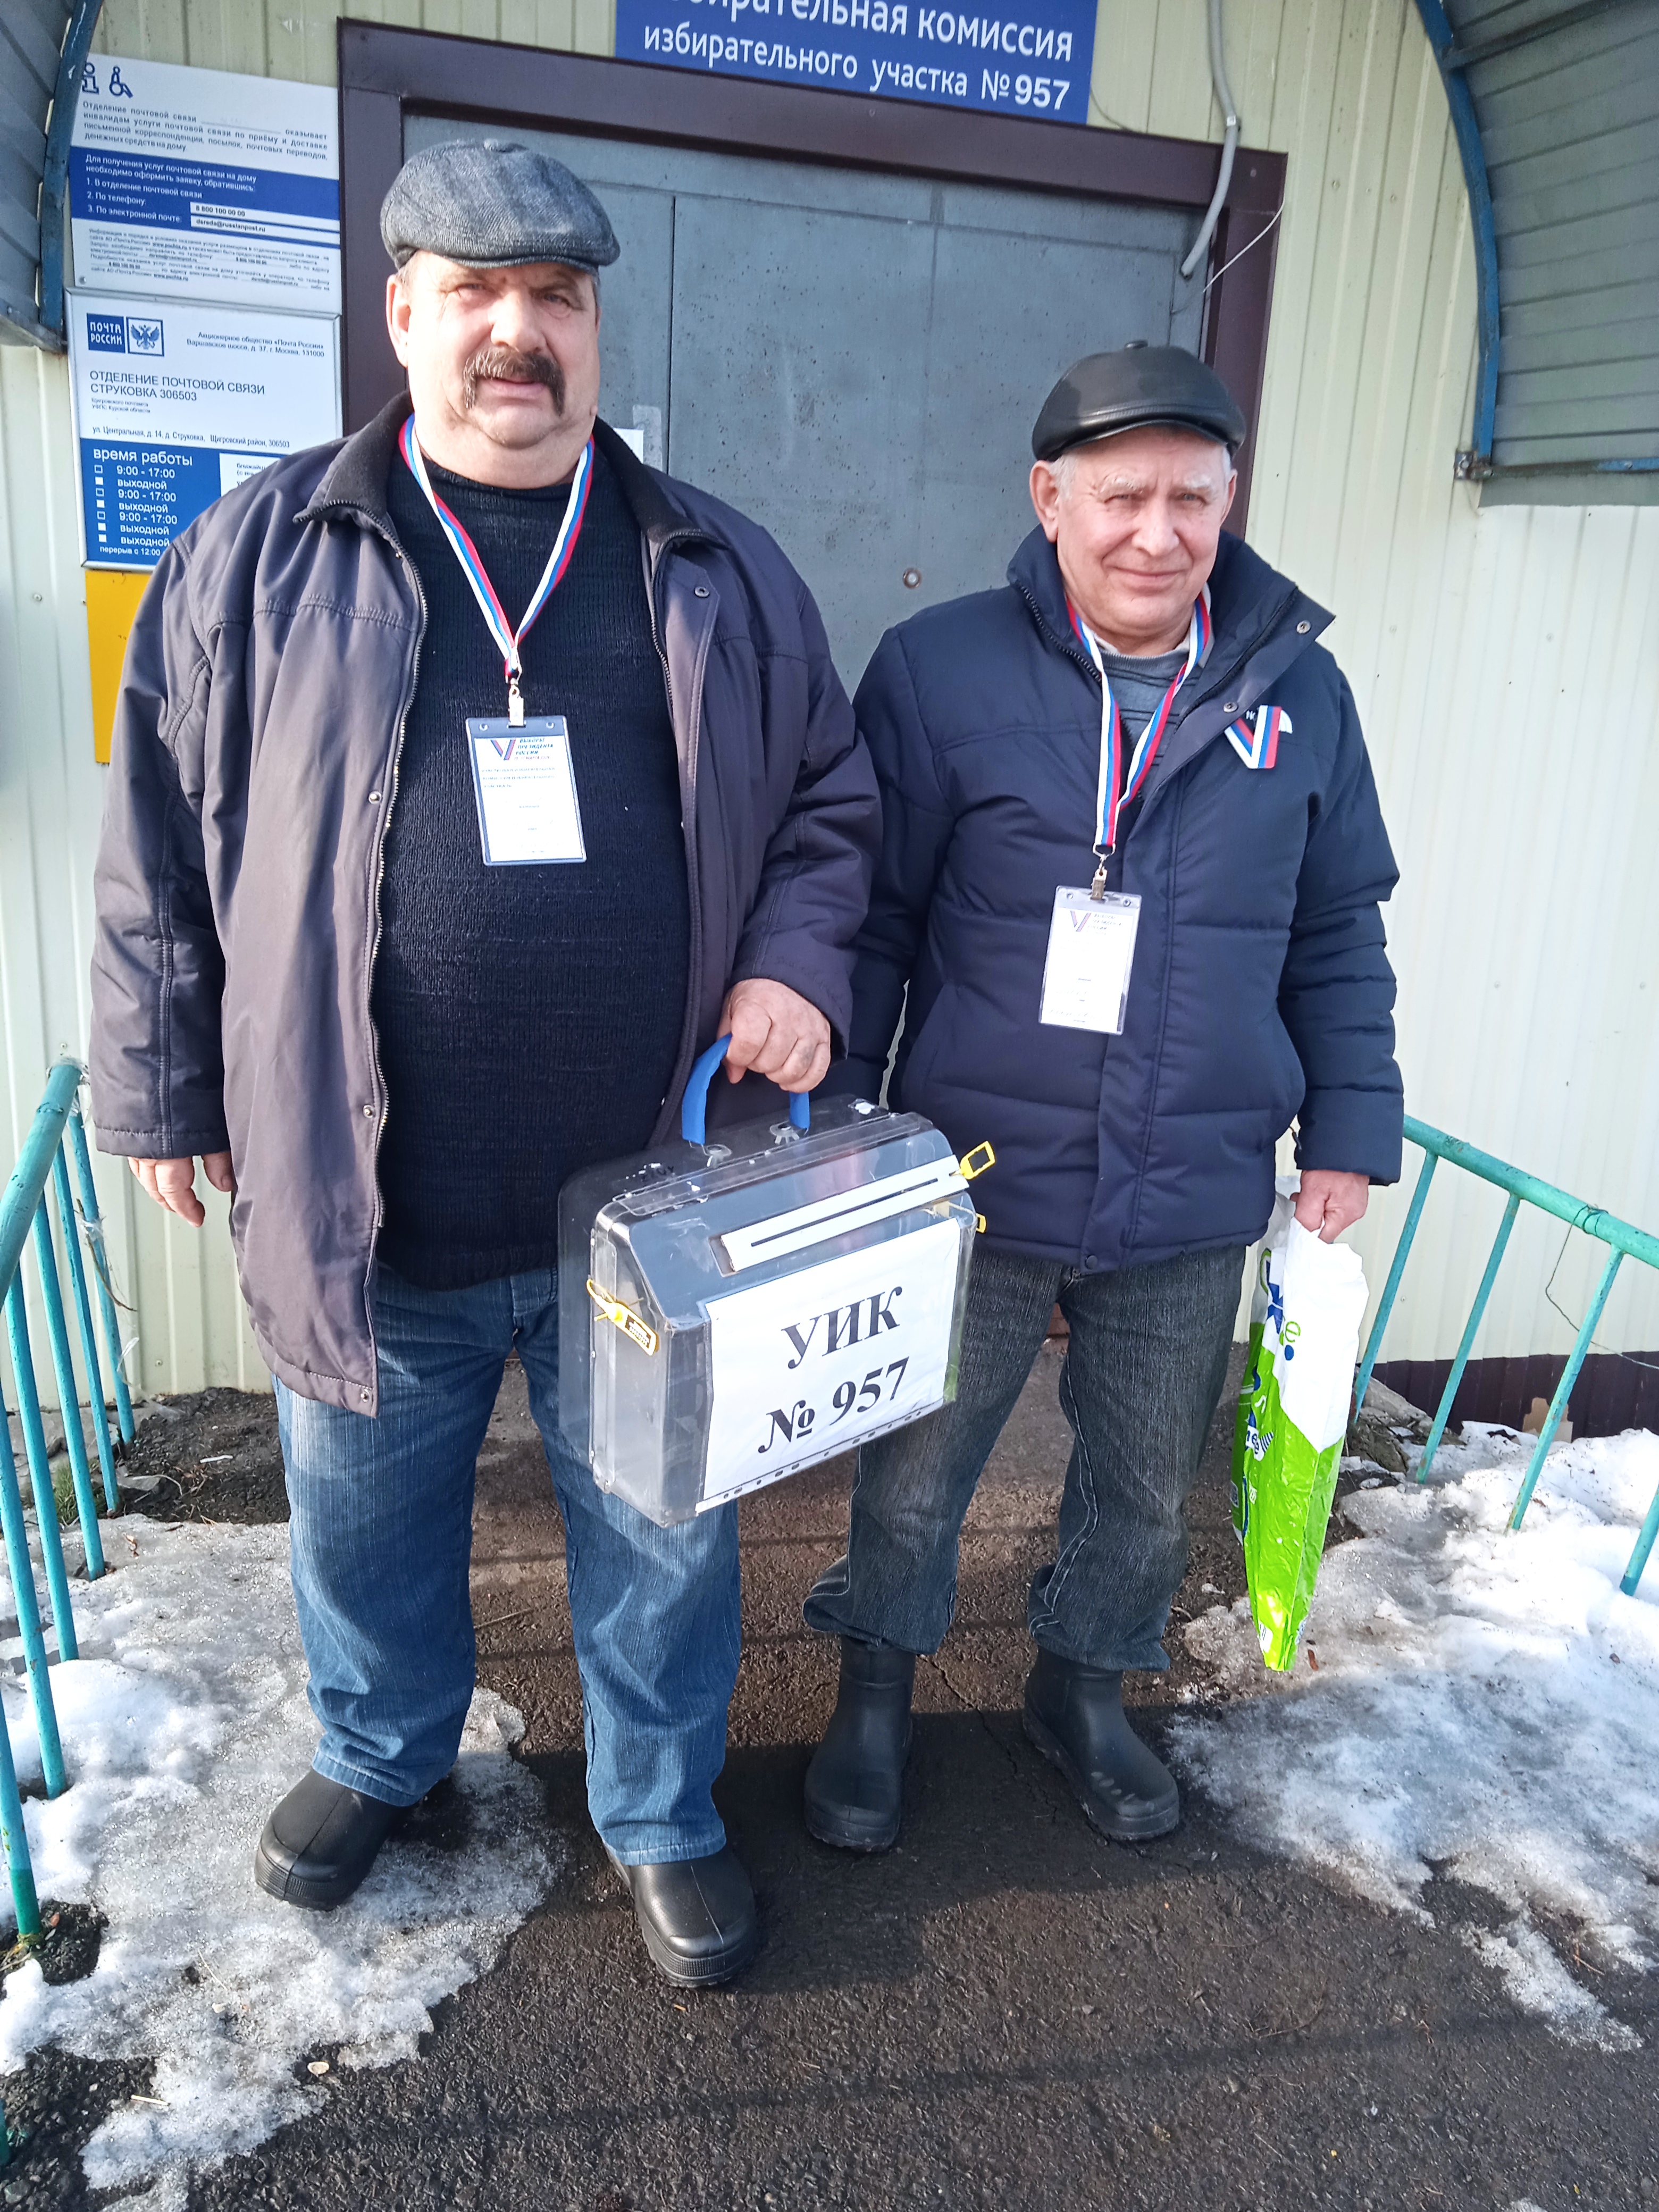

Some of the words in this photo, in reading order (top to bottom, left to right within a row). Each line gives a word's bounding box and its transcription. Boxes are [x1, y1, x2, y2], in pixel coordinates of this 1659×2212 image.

[918, 8, 1073, 62] комиссия
[644, 21, 858, 79] избирательного
[869, 58, 968, 96] участка
[82, 101, 126, 113] Отделение
[130, 108, 169, 118] почтовой
[284, 129, 326, 139] оказывает
[83, 112, 129, 123] инвалидам
[133, 119, 161, 128] услуги
[164, 122, 203, 132] почтовой
[248, 134, 278, 144] приёму
[290, 139, 327, 149] доставке
[83, 122, 130, 133] письменной
[246, 143, 282, 153] почтовых
[84, 132, 122, 142] денежных
[124, 137, 155, 146] средств
[85, 154, 100, 163] Для
[102, 157, 142, 167] получения
[144, 162, 164, 172] услуг
[165, 165, 201, 175] почтовой
[236, 174, 256, 183] дому
[85, 165, 132, 176] необходимо
[133, 171, 173, 181] оформить
[175, 176, 202, 186] заявку,
[95, 191, 106, 200] По
[101, 181, 141, 191] отделение
[143, 186, 178, 195] почтовой
[180, 190, 202, 198] связи
[96, 205, 106, 214] По
[108, 208, 156, 219] электронной
[89, 322, 121, 333] ПОЧТА
[90, 333, 122, 345] РОССИИ
[186, 339, 225, 347] Варшавское
[197, 332, 240, 341] Акционерное
[89, 371, 158, 384] ОТДЕЛЕНИЕ
[162, 376, 224, 390] ПОЧТОВОЙ
[227, 382, 265, 394] СВЯЗИ
[89, 383, 157, 397] СТРУКОВКА
[159, 389, 197, 400] 306503
[210, 434, 246, 443] Щигровский
[93, 449, 137, 462] время
[140, 451, 193, 465] работы
[116, 465, 138, 475] 9:00
[148, 467, 175, 478] 17:00
[117, 479, 167, 490] выходной
[118, 489, 139, 499] 9:00
[149, 491, 176, 501] 17:00
[118, 502, 168, 513] выходной
[119, 512, 141, 522] 9:00
[150, 514, 178, 524] 17:00
[120, 525, 169, 535] выходной
[120, 537, 170, 548] выходной
[781, 1286, 902, 1369] УИК
[758, 1400, 815, 1454] №
[829, 1356, 910, 1426] 957
